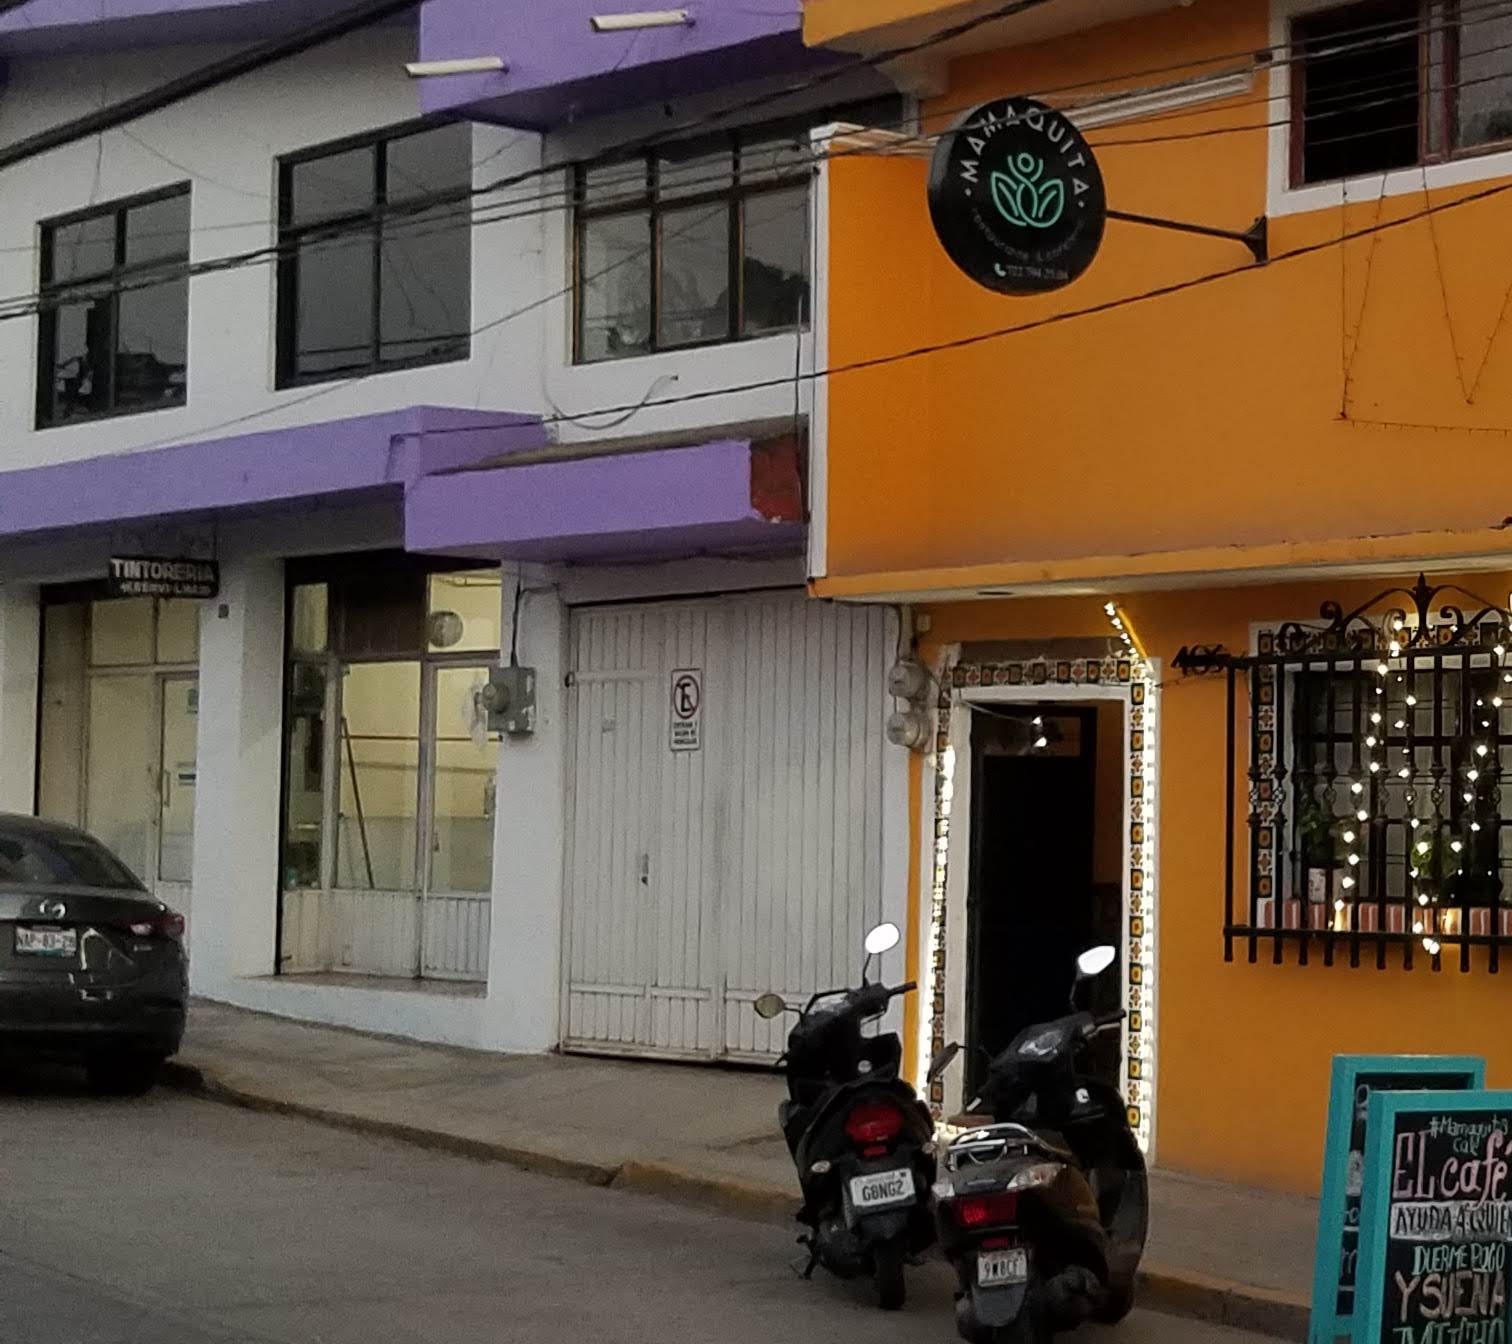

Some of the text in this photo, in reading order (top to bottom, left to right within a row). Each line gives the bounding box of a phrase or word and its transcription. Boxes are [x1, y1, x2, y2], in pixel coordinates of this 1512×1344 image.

[960, 104, 1090, 196] MAMAQUITA
[1395, 1205, 1453, 1236] AYUDA
[1411, 1244, 1468, 1276] DUERME
